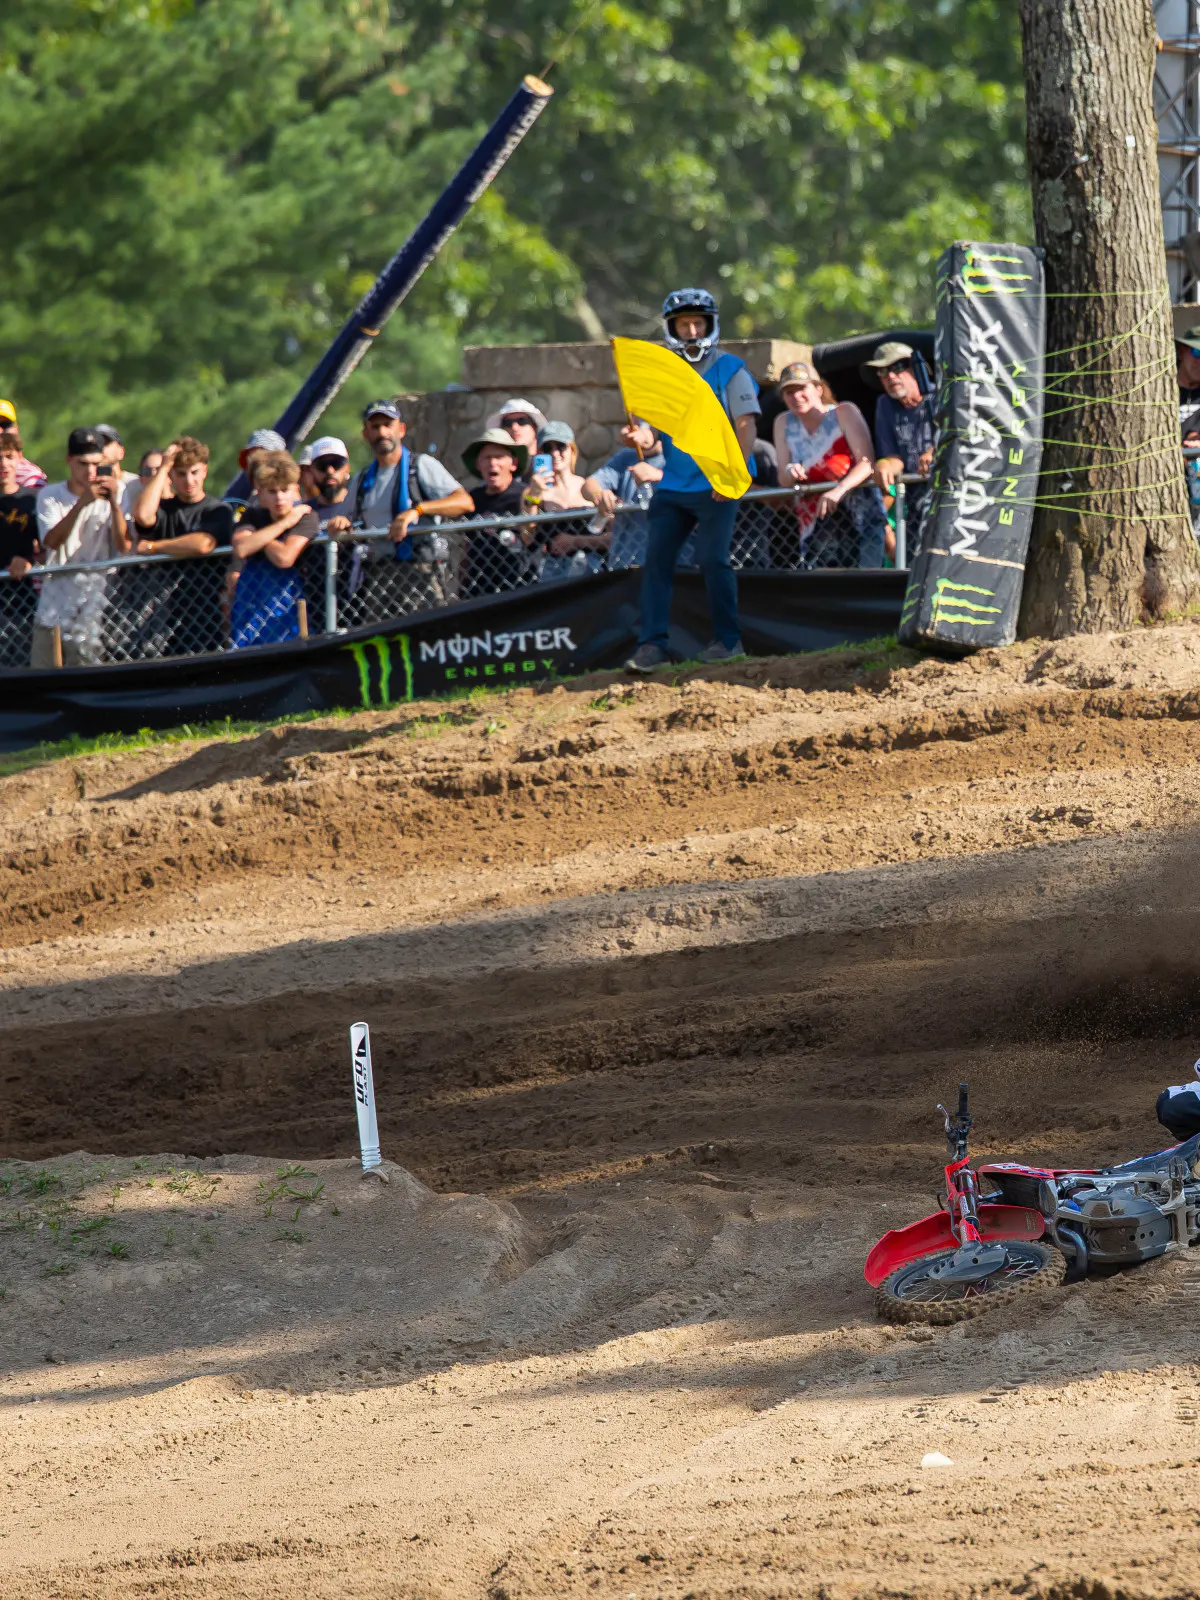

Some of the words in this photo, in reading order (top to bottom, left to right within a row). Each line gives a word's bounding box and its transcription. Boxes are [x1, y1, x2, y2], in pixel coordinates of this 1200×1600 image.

[949, 320, 1003, 556] MONSTER
[998, 360, 1027, 525] ENERGY
[419, 627, 577, 664] MONSTER
[444, 658, 554, 680] ENERGY
[355, 1059, 365, 1105] UFO
